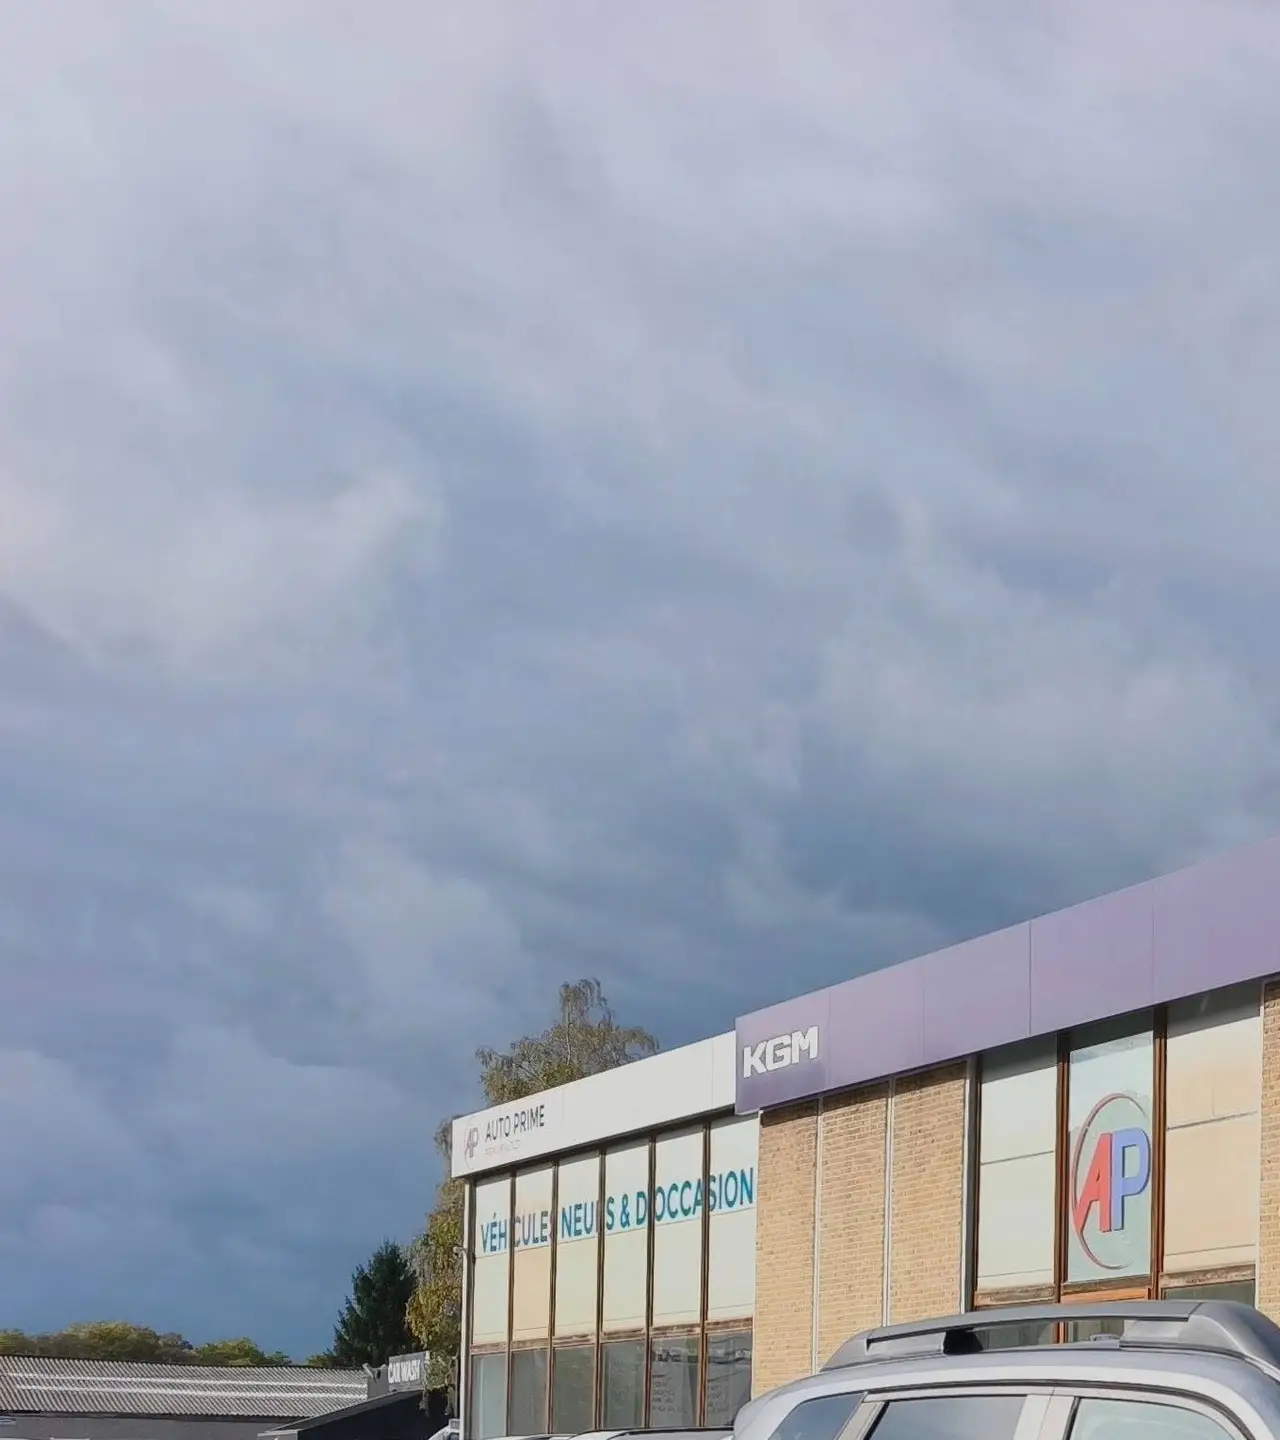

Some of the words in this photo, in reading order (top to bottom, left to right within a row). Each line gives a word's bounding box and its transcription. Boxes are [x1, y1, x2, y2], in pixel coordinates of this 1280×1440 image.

[743, 1025, 819, 1079] KGM
[485, 1115, 511, 1143] AUTO
[513, 1104, 545, 1135] PRIME
[619, 1193, 630, 1229] &
